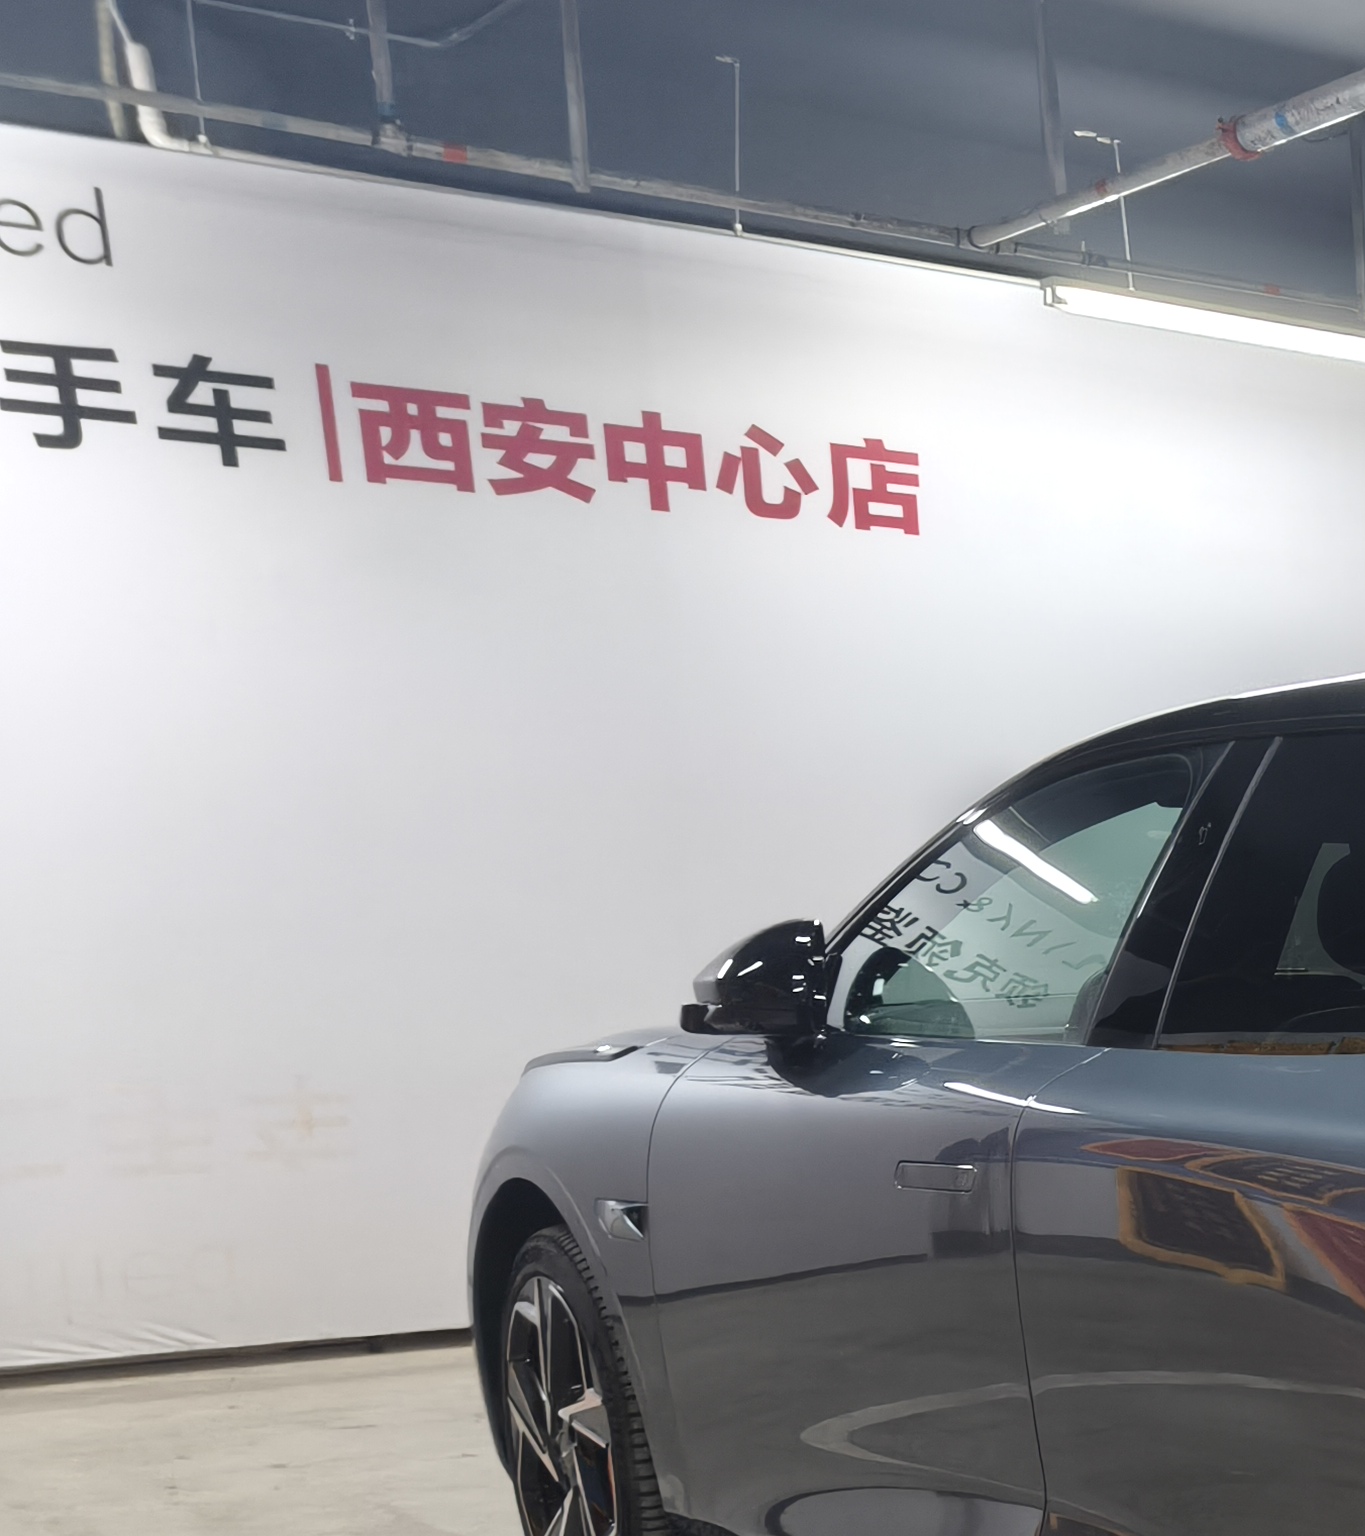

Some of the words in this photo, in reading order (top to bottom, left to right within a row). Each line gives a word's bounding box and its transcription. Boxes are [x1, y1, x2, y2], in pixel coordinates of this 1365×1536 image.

[349, 379, 922, 536] 西安中心店
